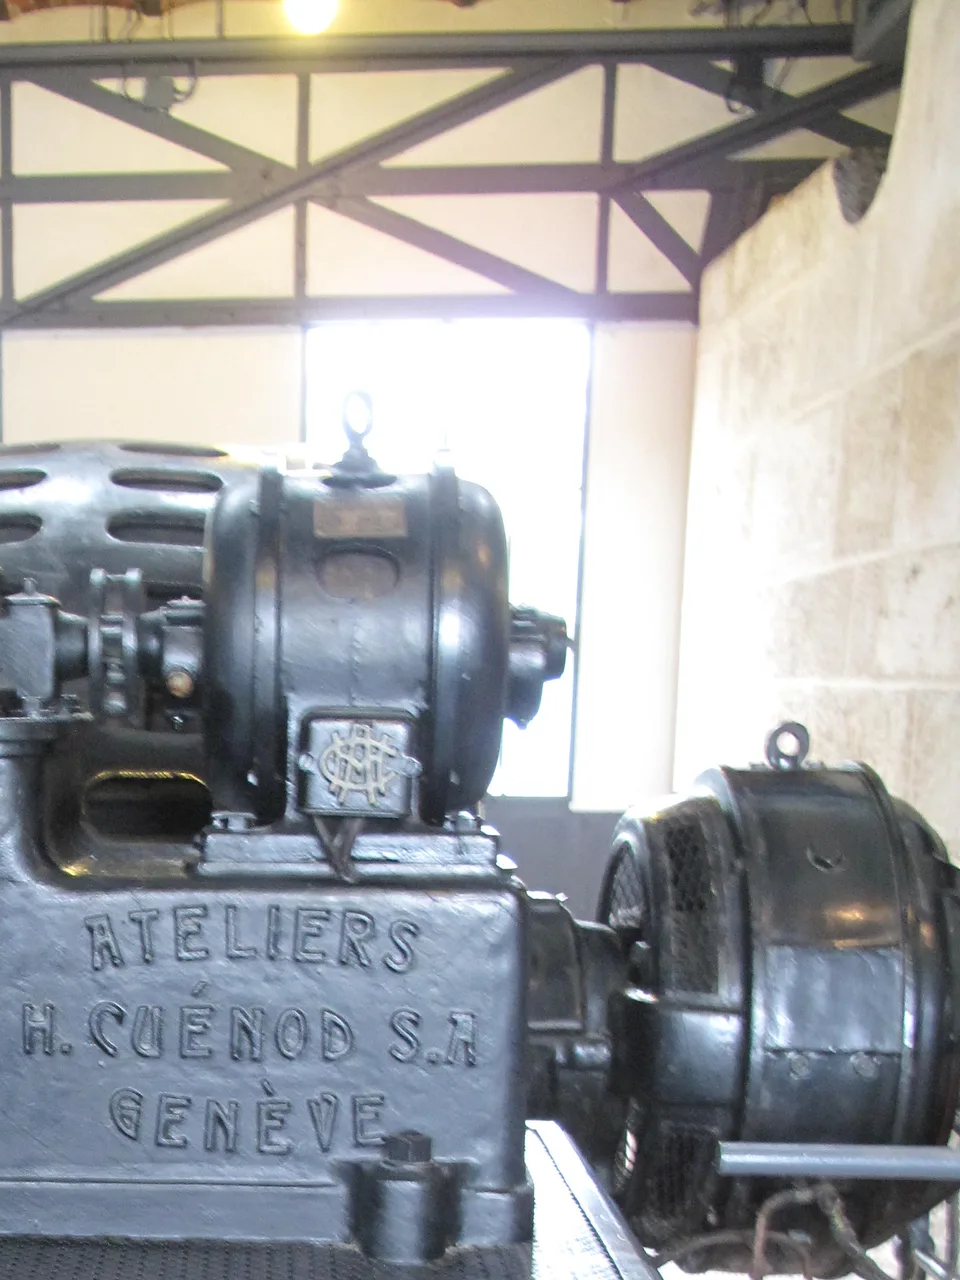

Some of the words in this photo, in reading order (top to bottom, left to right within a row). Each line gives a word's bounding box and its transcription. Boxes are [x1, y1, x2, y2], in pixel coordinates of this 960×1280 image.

[85, 904, 421, 974] ATELIERS
[22, 1001, 72, 1056] H.
[88, 979, 354, 1062] CUÉNOD
[109, 1079, 387, 1156] GENÈVE
